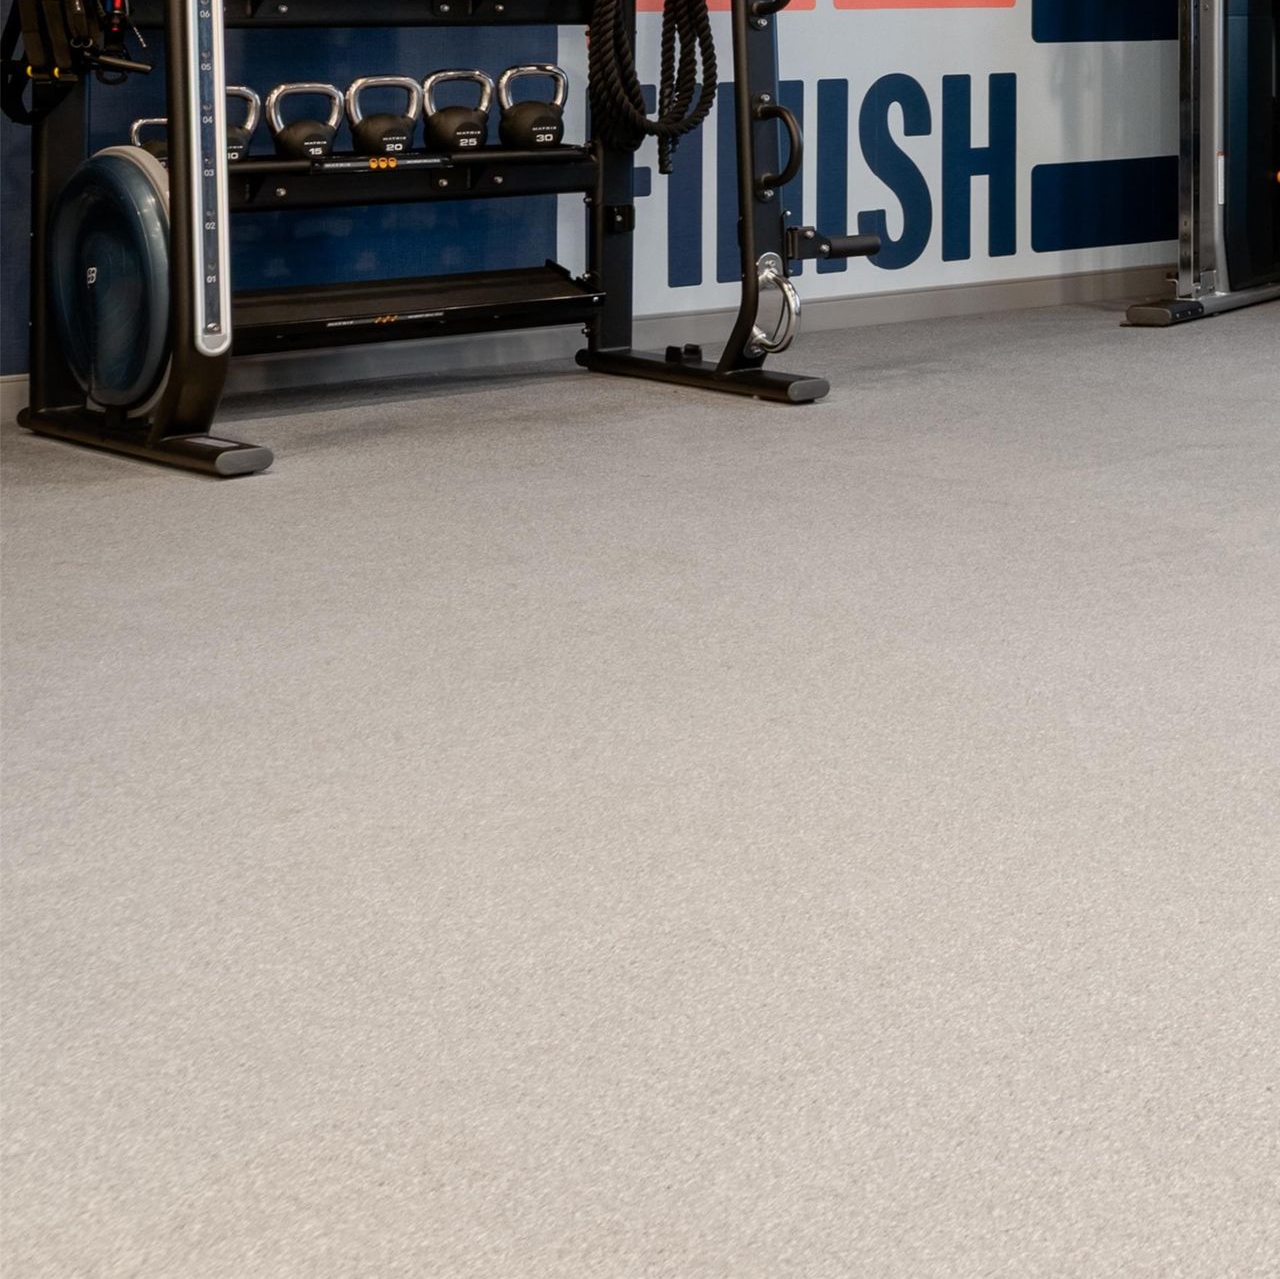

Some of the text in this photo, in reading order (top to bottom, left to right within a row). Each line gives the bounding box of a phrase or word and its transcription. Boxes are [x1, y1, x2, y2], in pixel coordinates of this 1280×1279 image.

[200, 10, 210, 18] 06
[201, 63, 212, 71] 05
[202, 116, 213, 124] 04
[460, 138, 478, 146] 25
[536, 134, 553, 142] 30
[309, 147, 323, 155] 15
[228, 152, 239, 160] 10
[204, 169, 214, 177] 03
[586, 72, 1017, 288] IISH
[205, 222, 216, 230] 02
[207, 275, 216, 283] 01
